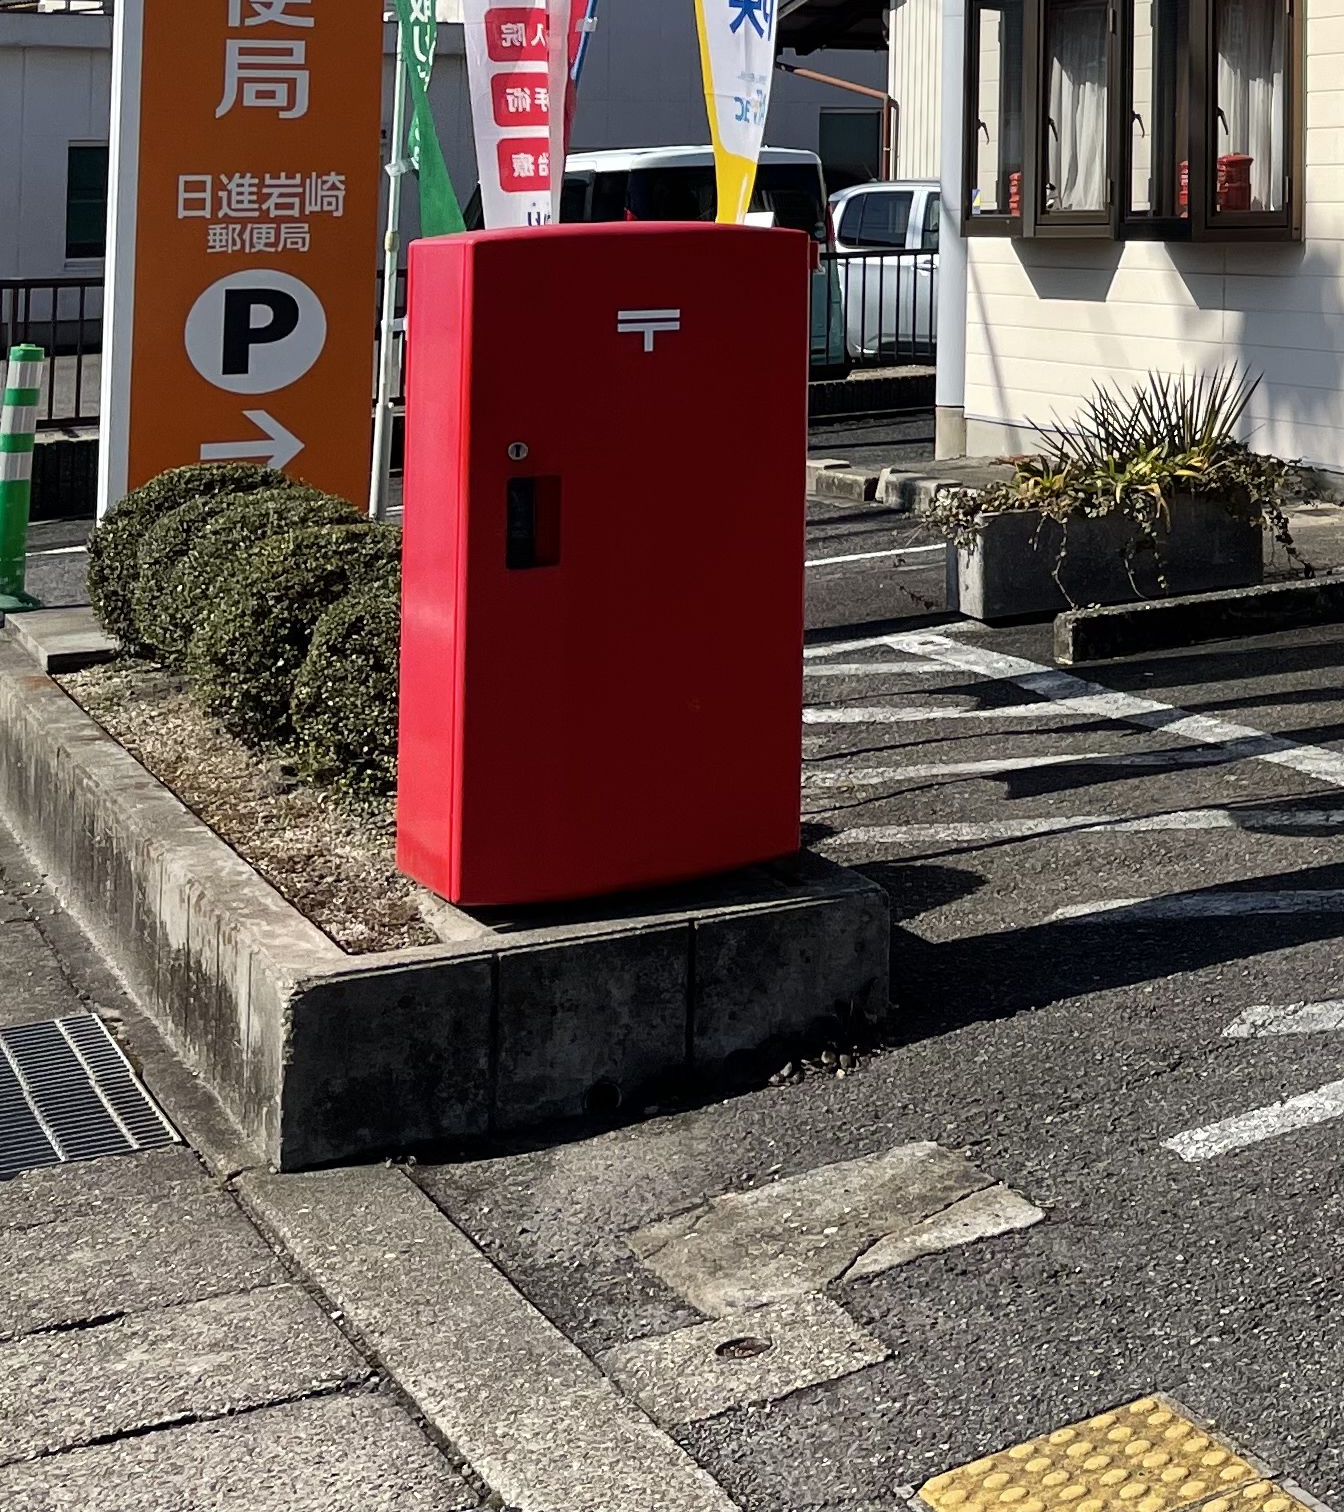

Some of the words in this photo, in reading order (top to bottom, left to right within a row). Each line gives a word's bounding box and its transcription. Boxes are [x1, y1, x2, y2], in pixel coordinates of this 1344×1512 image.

[177, 171, 347, 219] 日進岩崎
[207, 223, 311, 254] 郵便局
[222, 288, 299, 376] P
